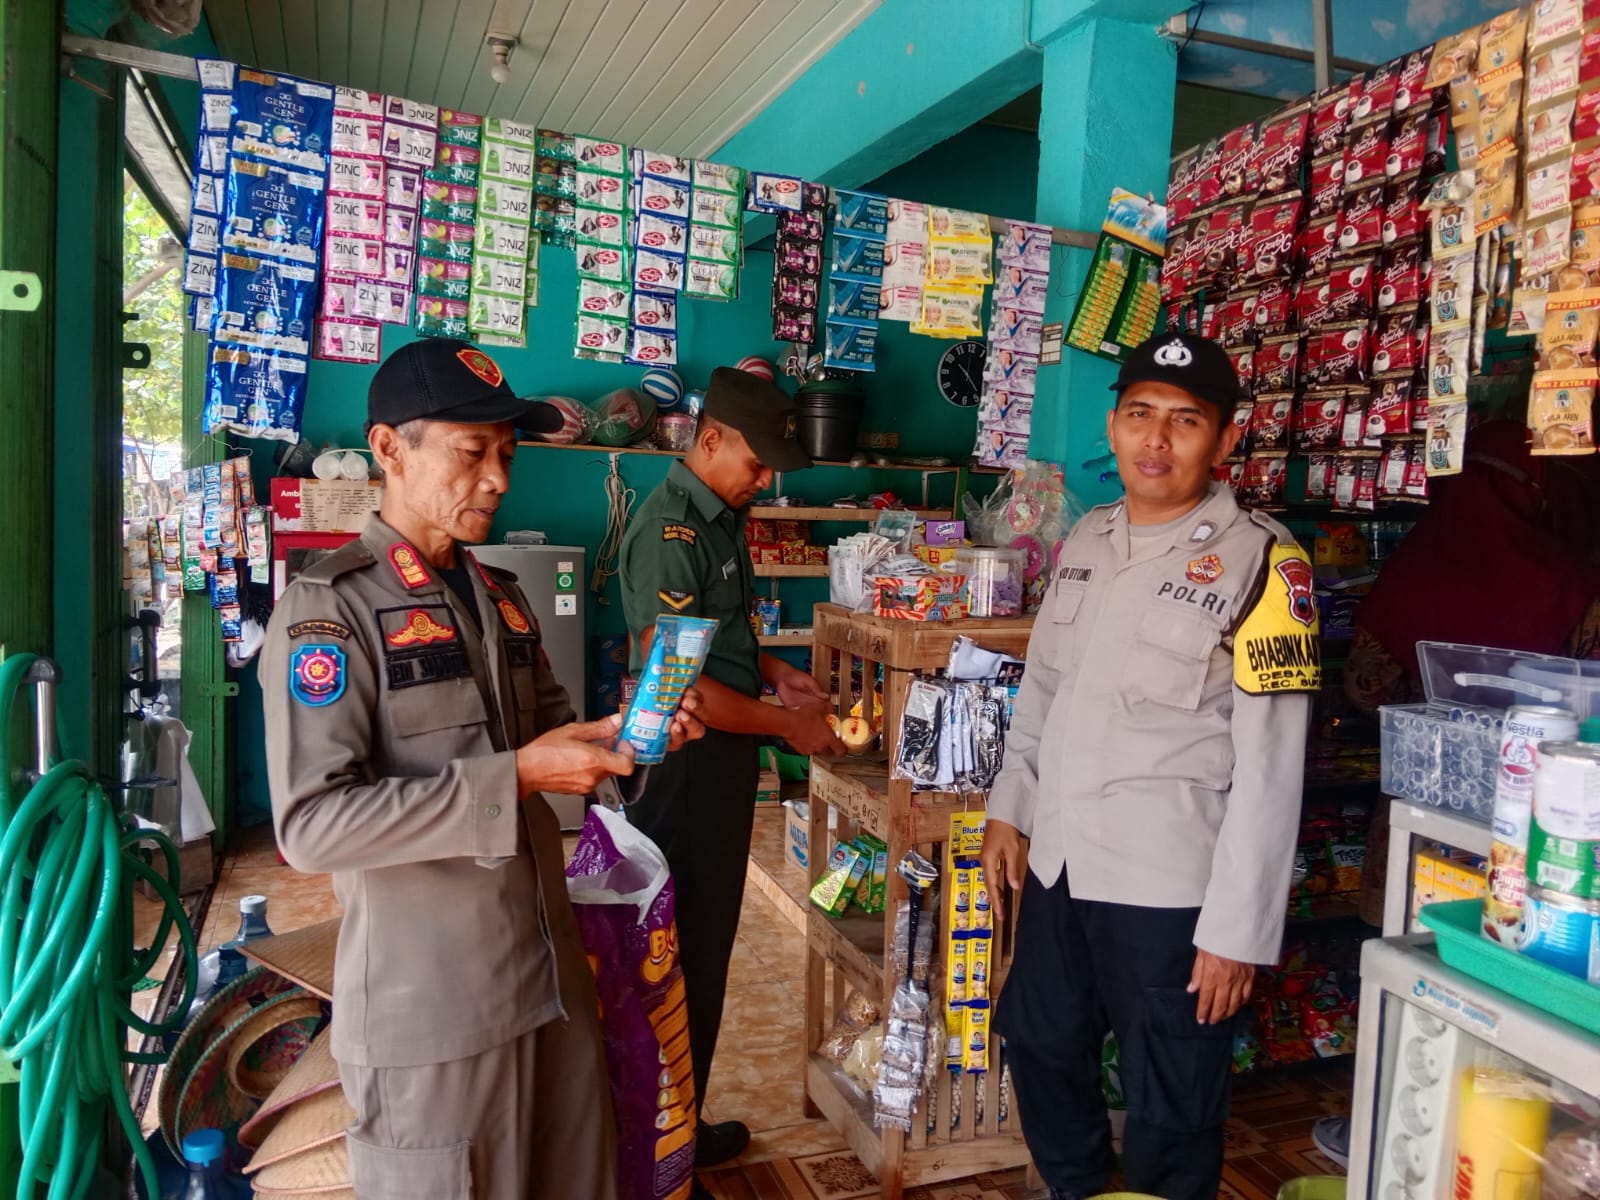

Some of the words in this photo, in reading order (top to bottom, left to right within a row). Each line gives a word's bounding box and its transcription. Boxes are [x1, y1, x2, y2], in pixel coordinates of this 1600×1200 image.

[336, 86, 362, 100] ZINC
[408, 108, 435, 122] ZINC
[334, 122, 361, 137] ZINC
[452, 128, 478, 142] ZINC
[506, 126, 532, 138] ZINC
[406, 144, 432, 158] ZINC
[334, 162, 360, 177] ZINC
[451, 167, 476, 181] ZINC
[504, 162, 530, 176] ZINC
[333, 202, 360, 217] ZINC
[448, 204, 472, 219] ZINC
[502, 200, 528, 213] ZINC
[1436, 213, 1467, 230] TOP
[197, 223, 216, 236] ZIN
[333, 241, 360, 256] ZINC
[500, 238, 524, 250] ZINC
[444, 282, 468, 296] ZINC
[496, 276, 522, 288] ZINC
[359, 288, 386, 302] ZINC
[1434, 288, 1461, 306] TOP
[442, 320, 466, 333] ZINC
[494, 313, 518, 326] ZINC
[349, 340, 376, 354] ZINC
[968, 344, 976, 354] 12
[1158, 582, 1227, 616] POLRI
[1258, 670, 1306, 682] DESA
[1260, 680, 1294, 692] KEC.
